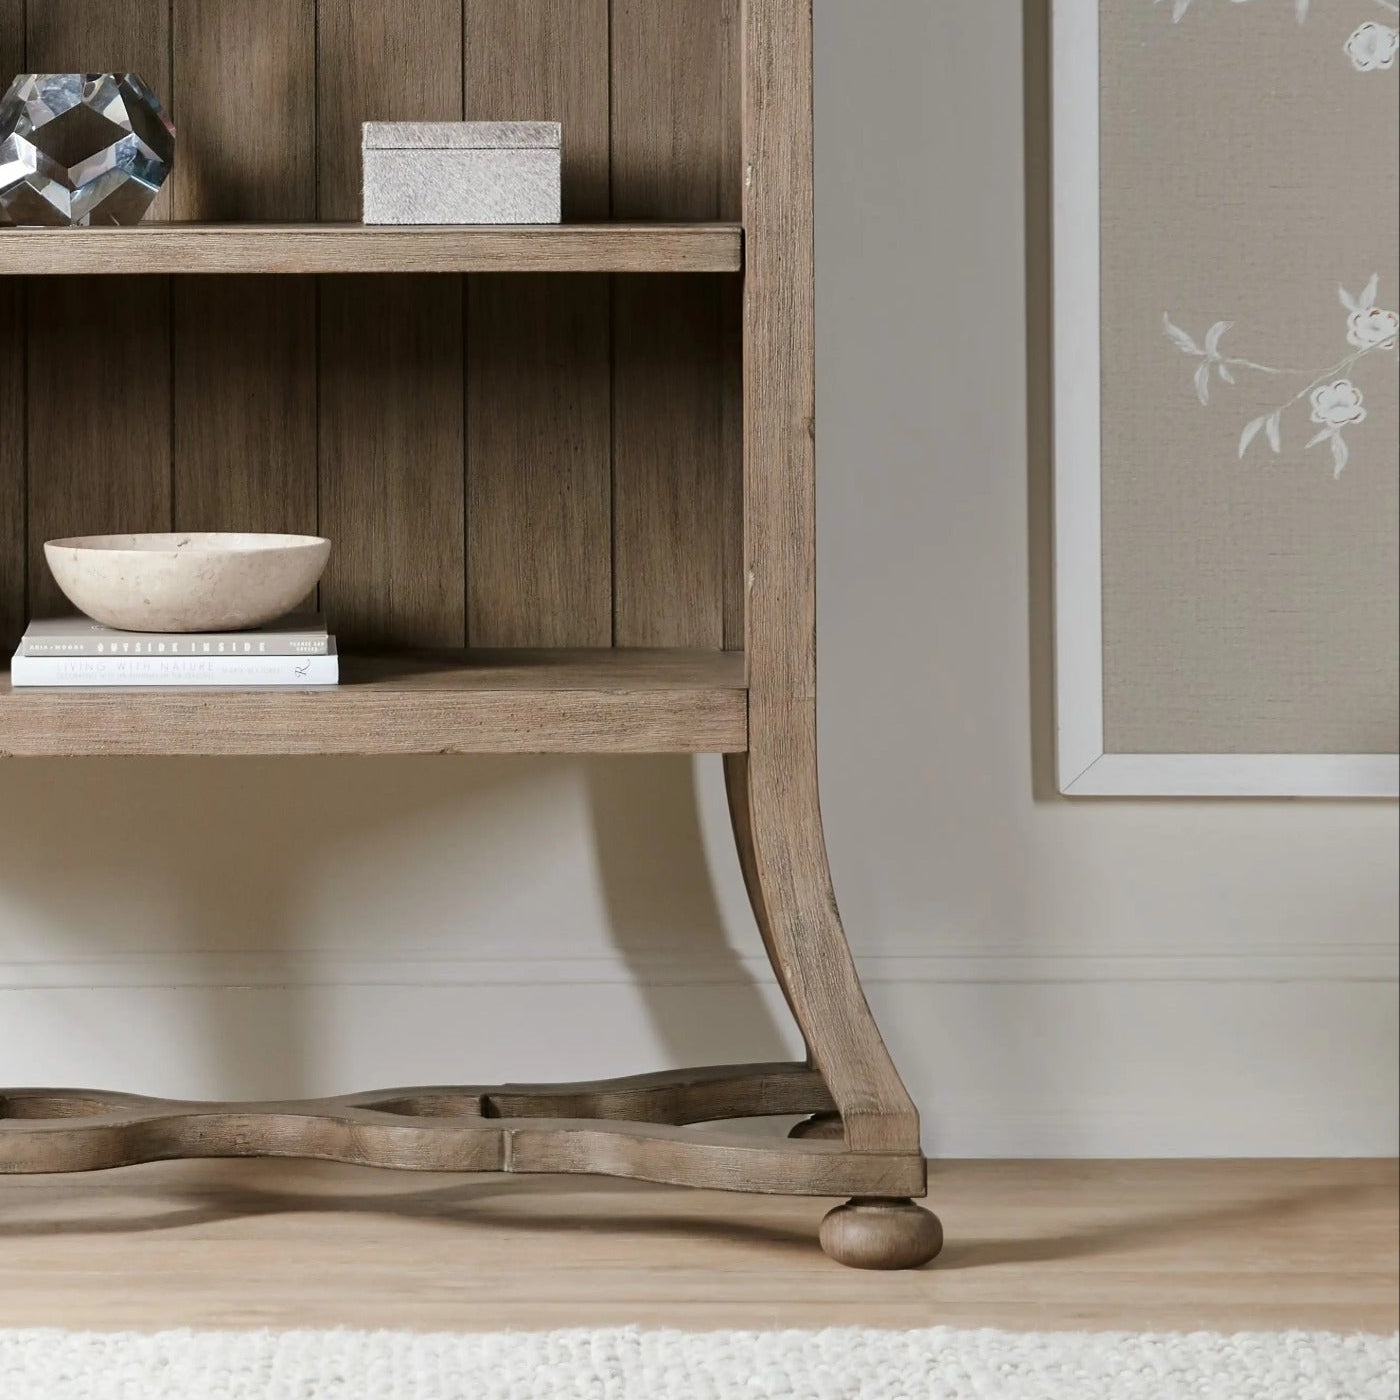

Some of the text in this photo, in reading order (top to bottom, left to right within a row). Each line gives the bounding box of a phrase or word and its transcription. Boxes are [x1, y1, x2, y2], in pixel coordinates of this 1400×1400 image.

[97, 642, 265, 652] OUTSIDE INSIDE
[56, 661, 106, 672] LIVING
[116, 661, 151, 672] WITH
[160, 660, 214, 672] NATURE
